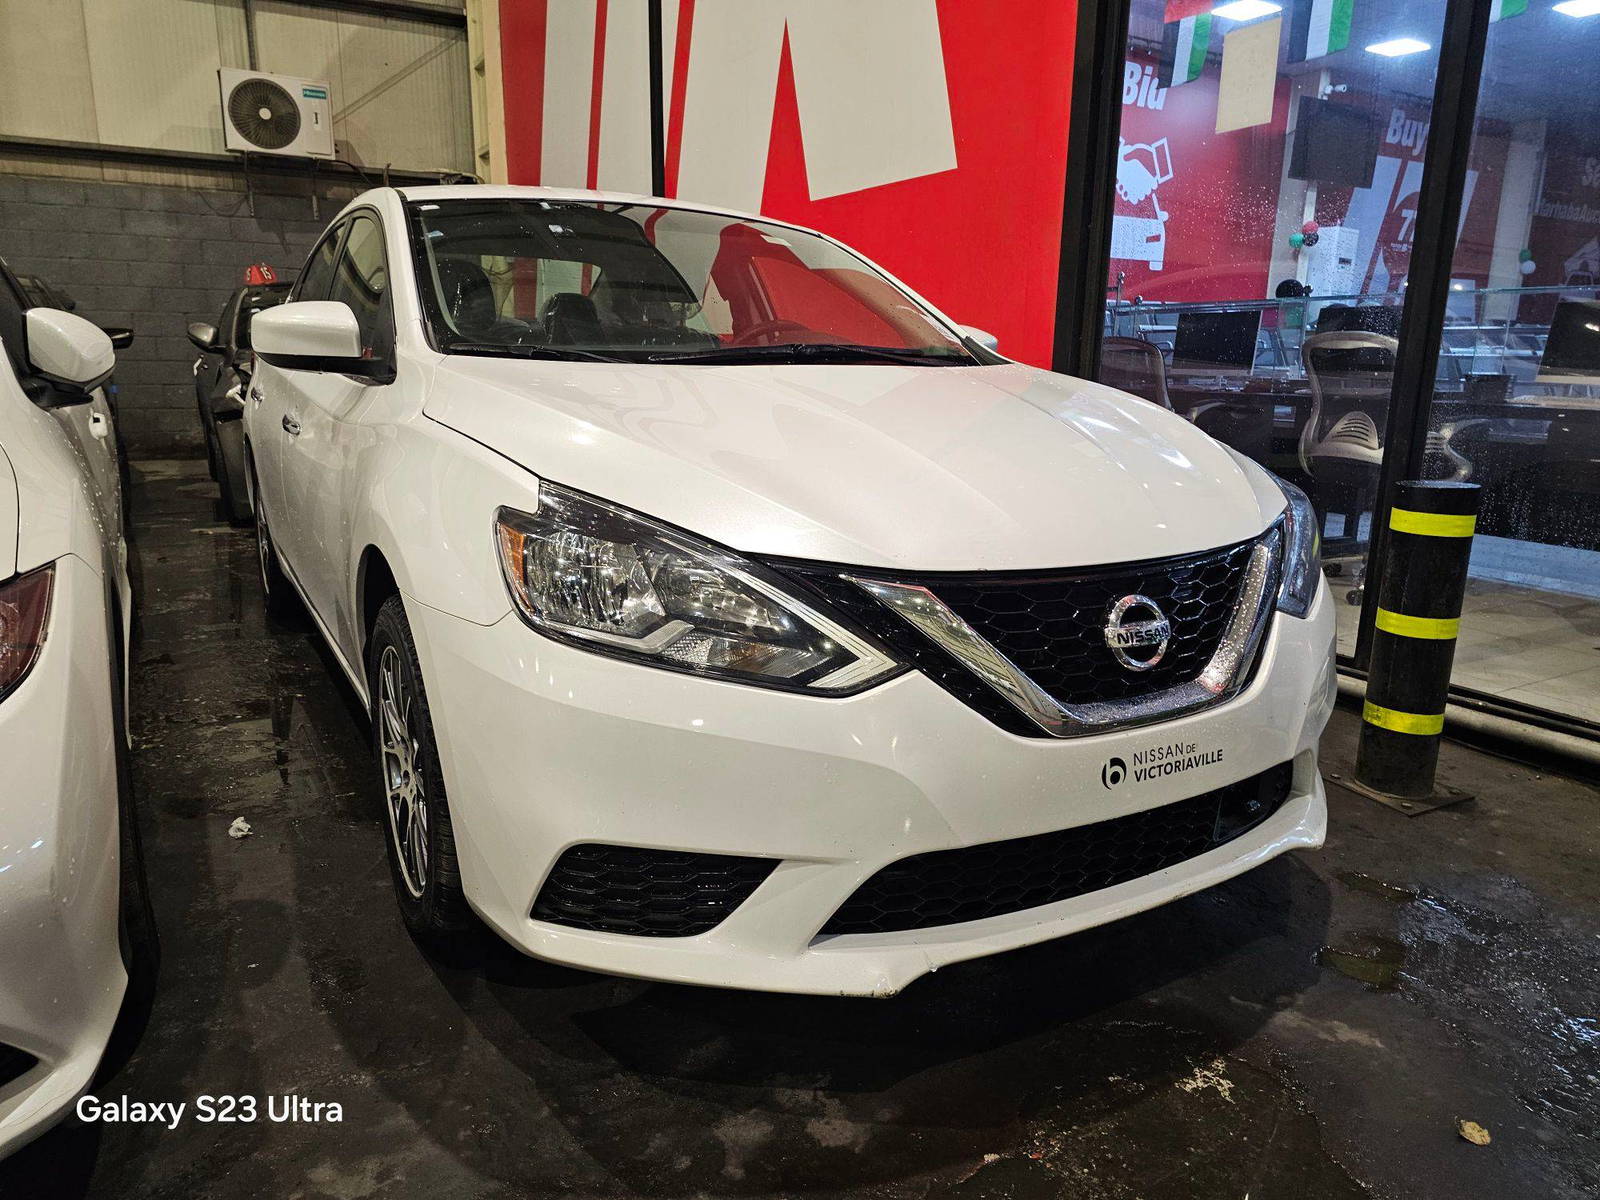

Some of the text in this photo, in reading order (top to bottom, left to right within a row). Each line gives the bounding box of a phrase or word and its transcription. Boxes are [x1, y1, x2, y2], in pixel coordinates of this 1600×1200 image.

[1385, 108, 1429, 156] Buy
[1116, 625, 1169, 645] NISSAN
[1133, 742, 1196, 766] NISSAN DE
[1134, 749, 1223, 782] VICTORIAVILLE
